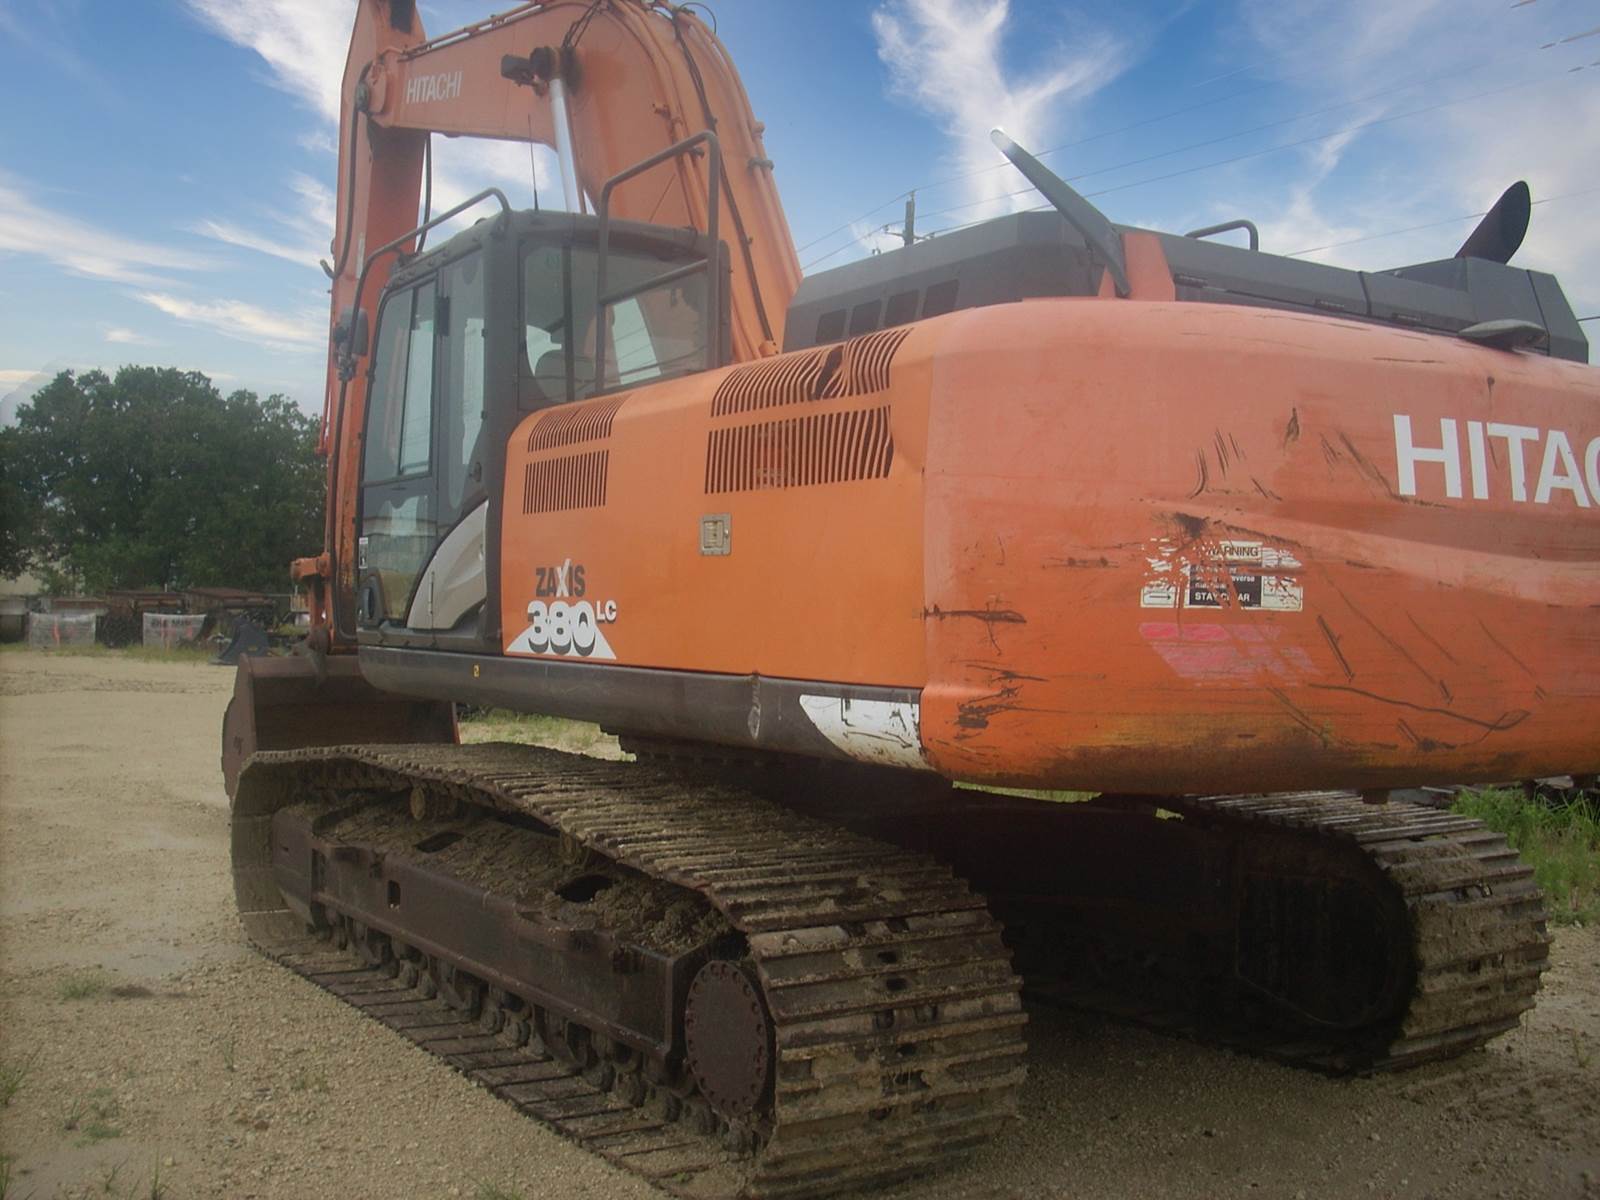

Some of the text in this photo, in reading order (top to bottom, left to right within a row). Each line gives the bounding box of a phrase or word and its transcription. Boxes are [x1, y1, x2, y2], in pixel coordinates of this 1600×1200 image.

[405, 71, 464, 105] HITACHI
[1393, 414, 1600, 508] HITA
[535, 559, 586, 598] ZAXIS
[1194, 591, 1250, 602] STAY CAR
